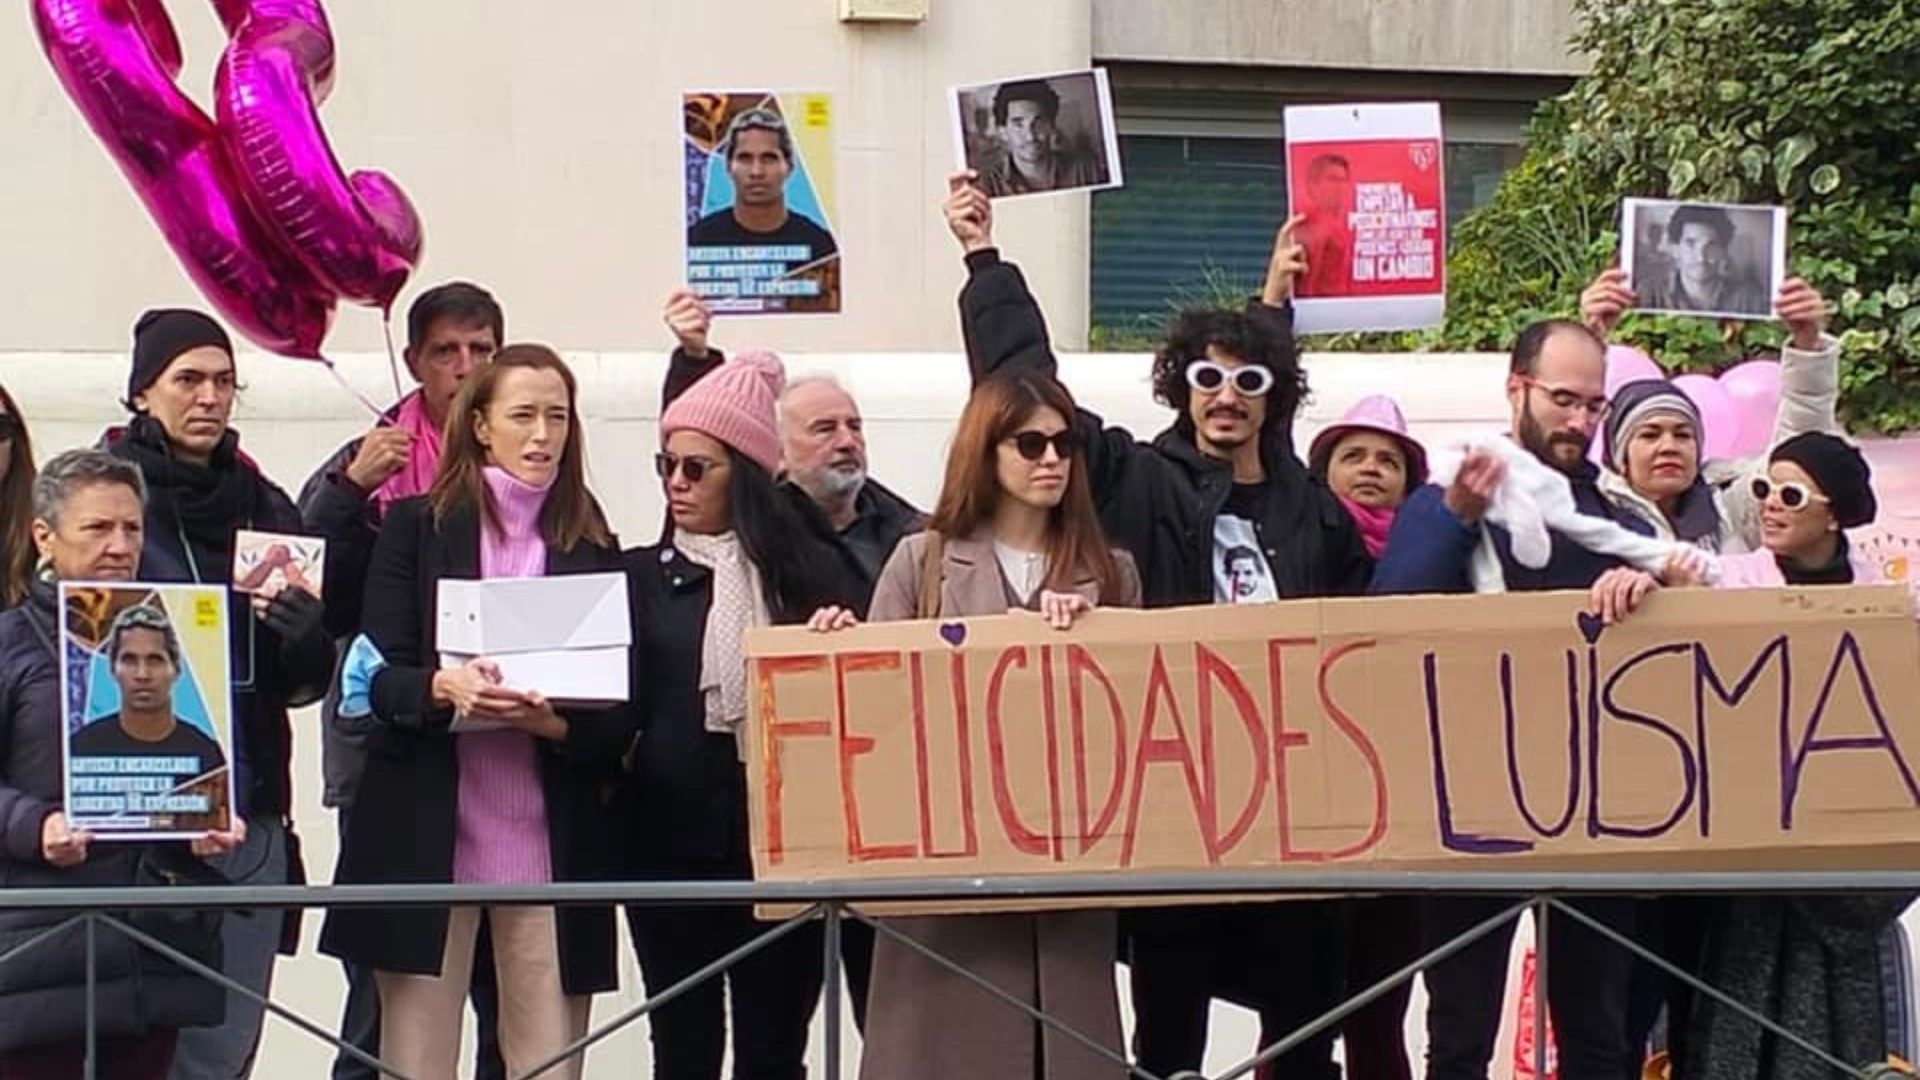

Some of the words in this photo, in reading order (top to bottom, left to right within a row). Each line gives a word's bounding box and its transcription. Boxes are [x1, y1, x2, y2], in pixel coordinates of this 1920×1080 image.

[1353, 256, 1376, 280] UN
[1378, 254, 1435, 279] CAMBIO
[757, 636, 1387, 866] FELICIDADES
[1424, 628, 1920, 853] LUISMA
